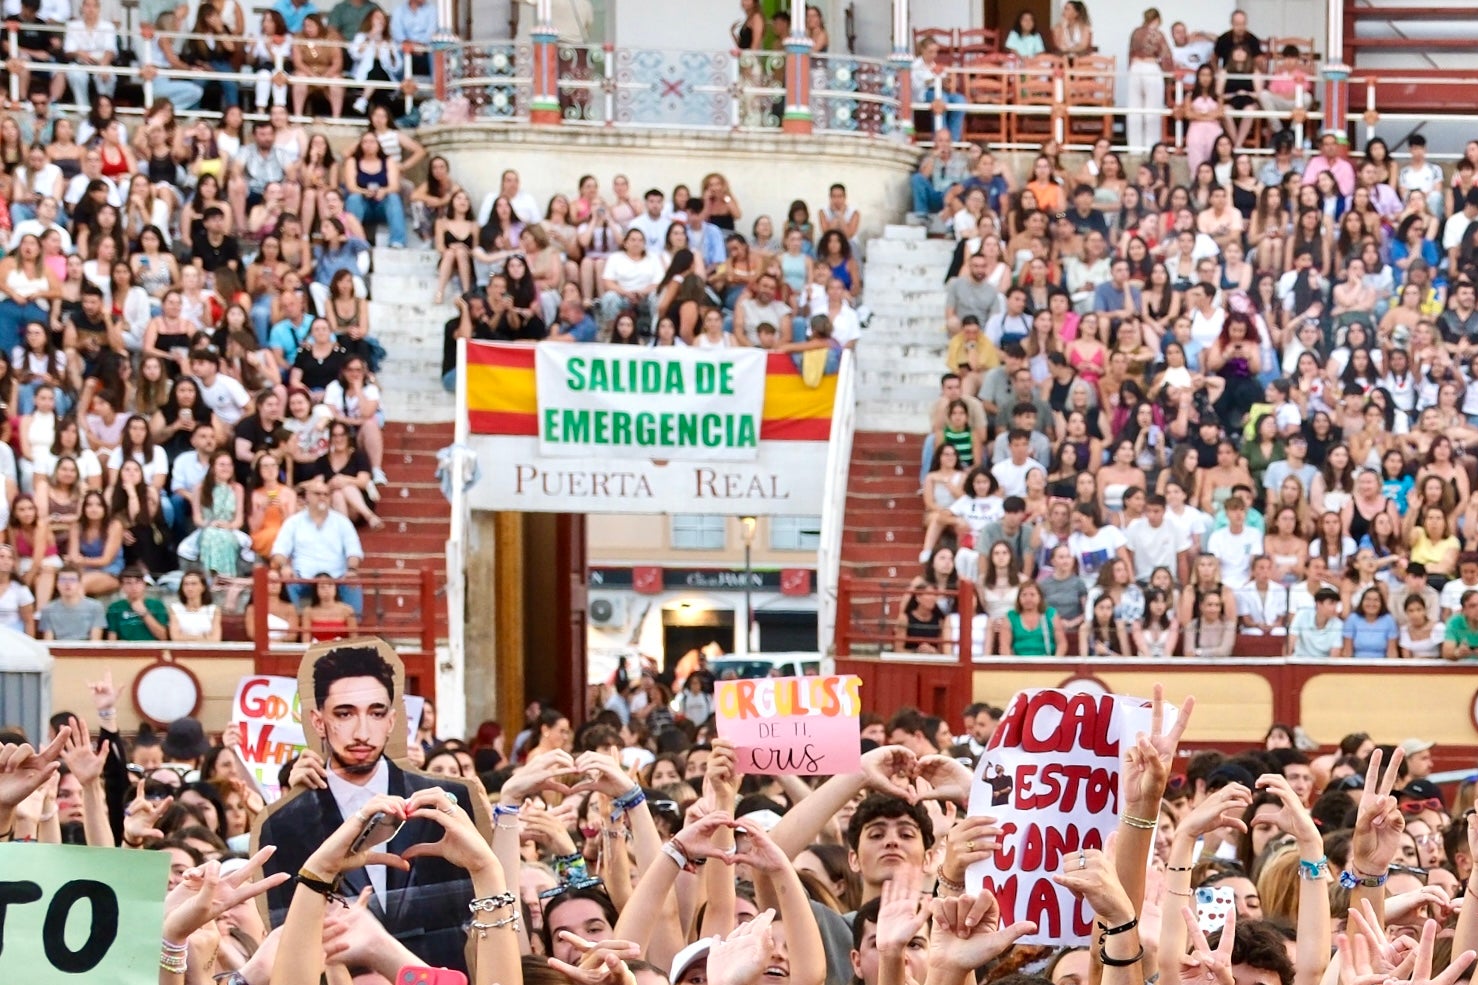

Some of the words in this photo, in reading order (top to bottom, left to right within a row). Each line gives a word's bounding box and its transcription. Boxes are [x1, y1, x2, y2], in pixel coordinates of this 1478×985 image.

[566, 357, 685, 395] SALIDA
[695, 361, 735, 396] DE
[543, 407, 757, 448] EMERGENCIA
[514, 464, 655, 498] PUERTA
[693, 466, 790, 500] REAL
[719, 675, 864, 720] ORGULLOSAS
[758, 722, 782, 739] DE
